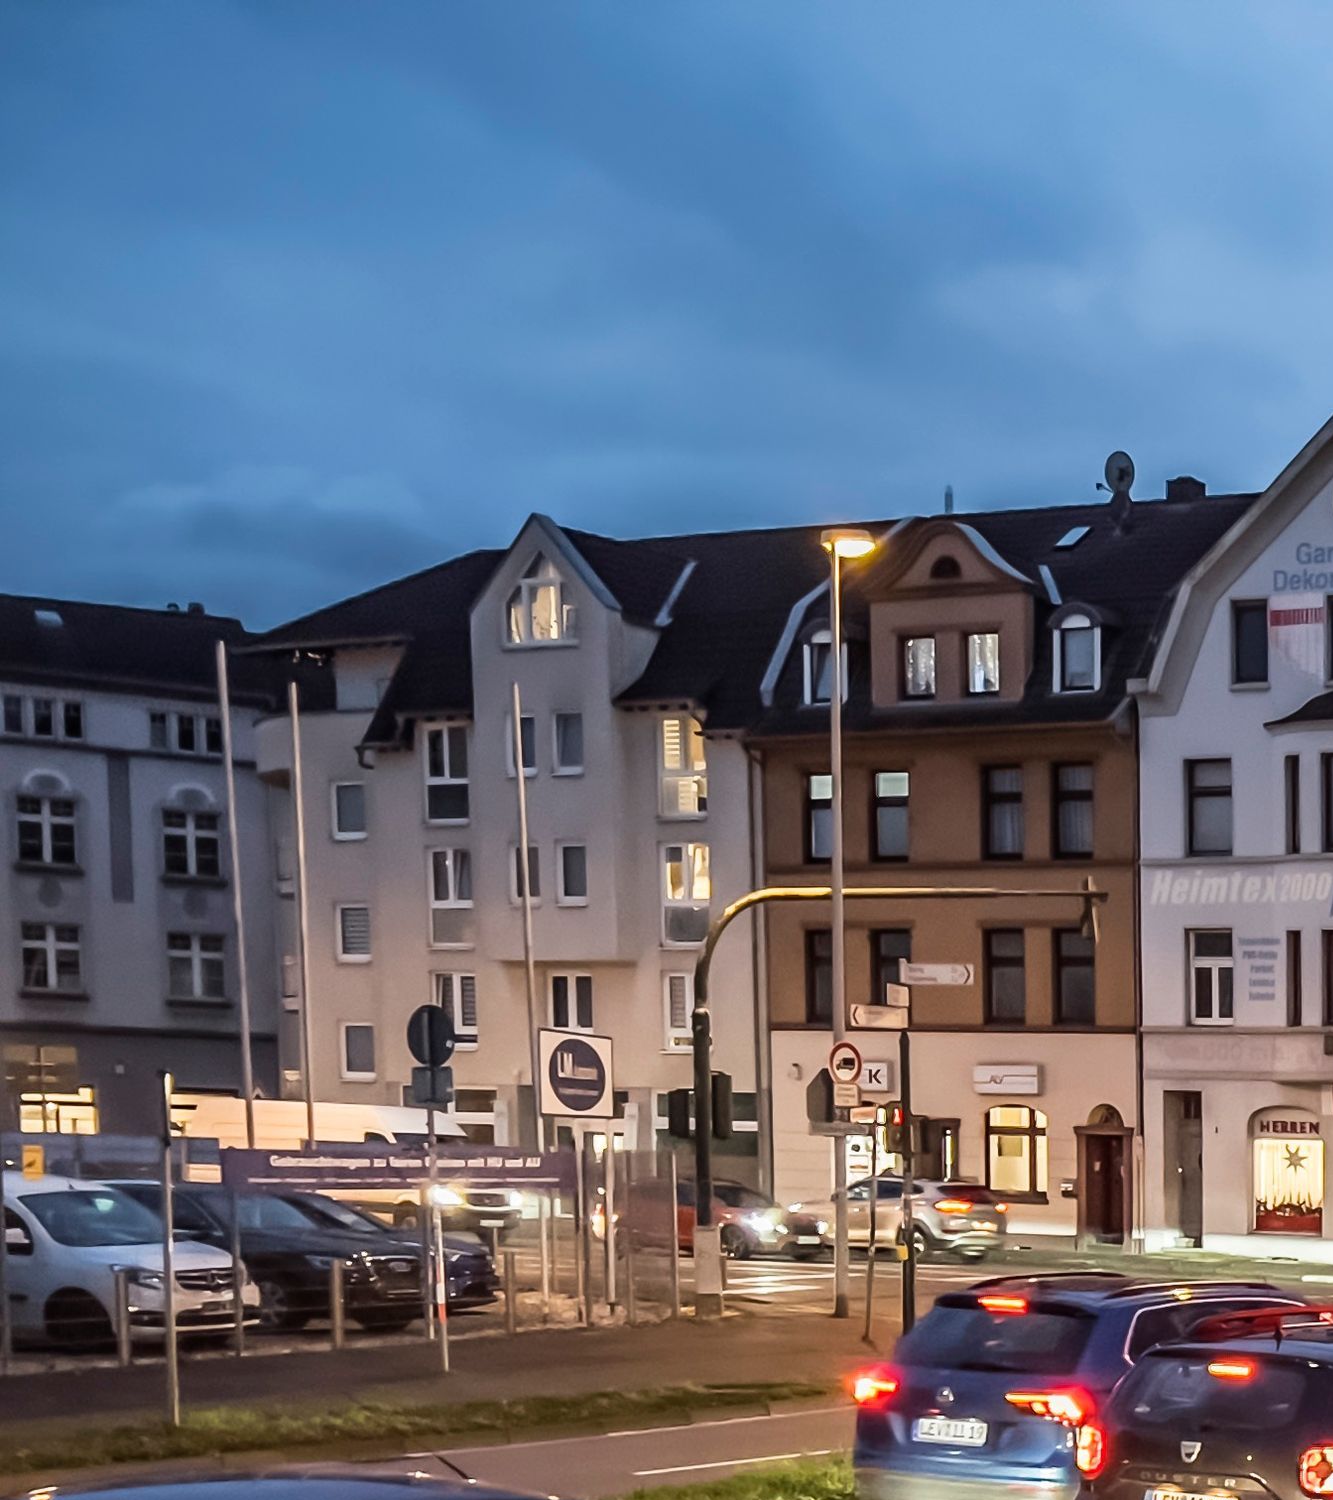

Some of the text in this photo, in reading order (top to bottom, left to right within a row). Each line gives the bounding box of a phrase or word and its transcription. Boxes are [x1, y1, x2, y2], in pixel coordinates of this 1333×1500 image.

[1151, 869, 1333, 905] Heimtex 2000
[1260, 1120, 1320, 1135] HERREN
[1141, 1471, 1236, 1488] DUSTER
